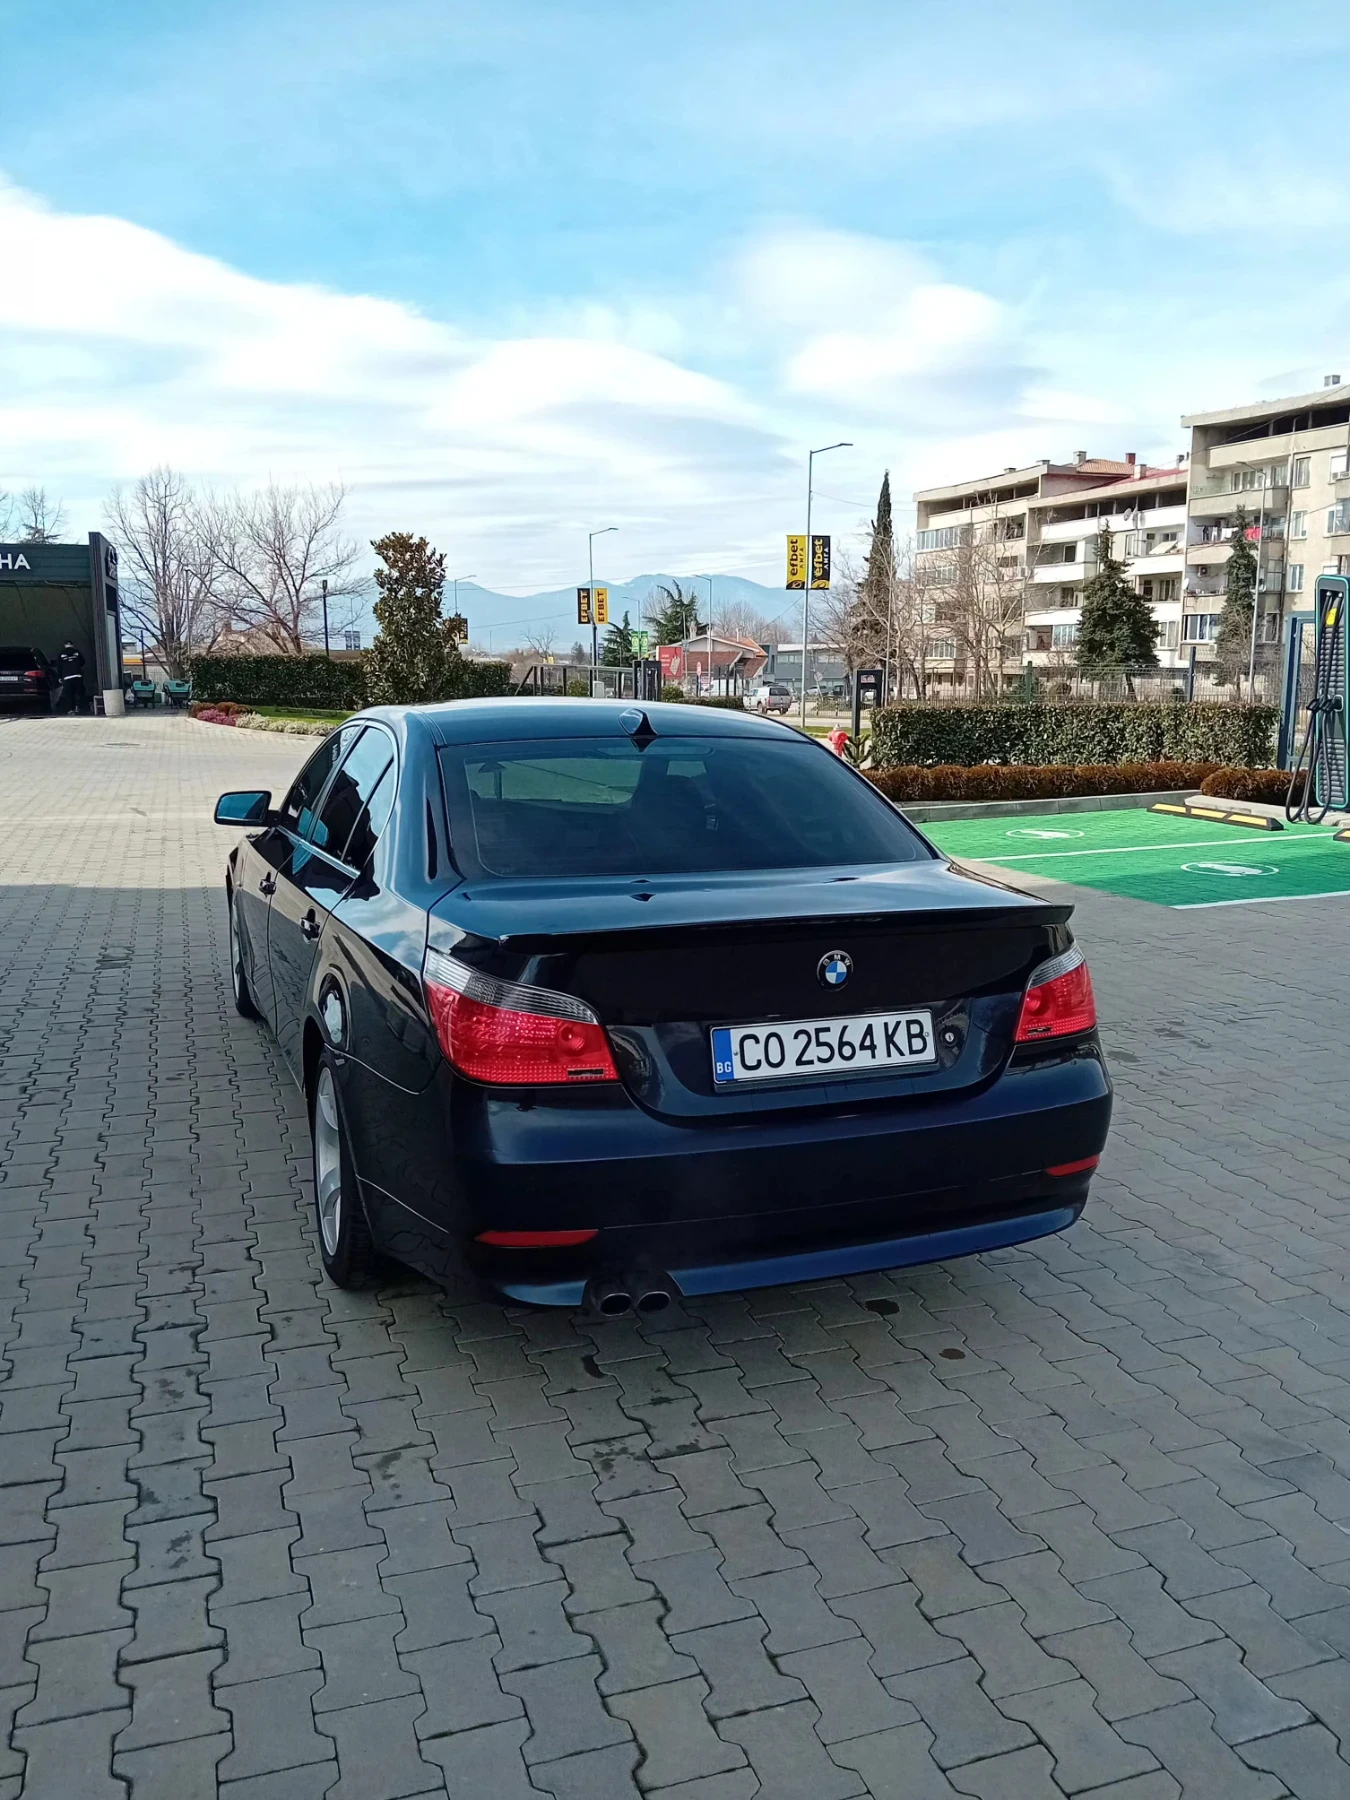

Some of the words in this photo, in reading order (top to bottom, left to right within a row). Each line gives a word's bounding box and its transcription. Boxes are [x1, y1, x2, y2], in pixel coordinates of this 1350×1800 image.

[789, 538, 799, 576] efbet
[813, 538, 824, 577] efbet
[579, 590, 588, 623] EFBET
[597, 590, 605, 622] EFBET
[822, 954, 851, 967] BMW
[738, 1031, 786, 1071] CO
[792, 1023, 878, 1067] 2564
[882, 1018, 928, 1058] KB
[716, 1061, 732, 1074] BG
